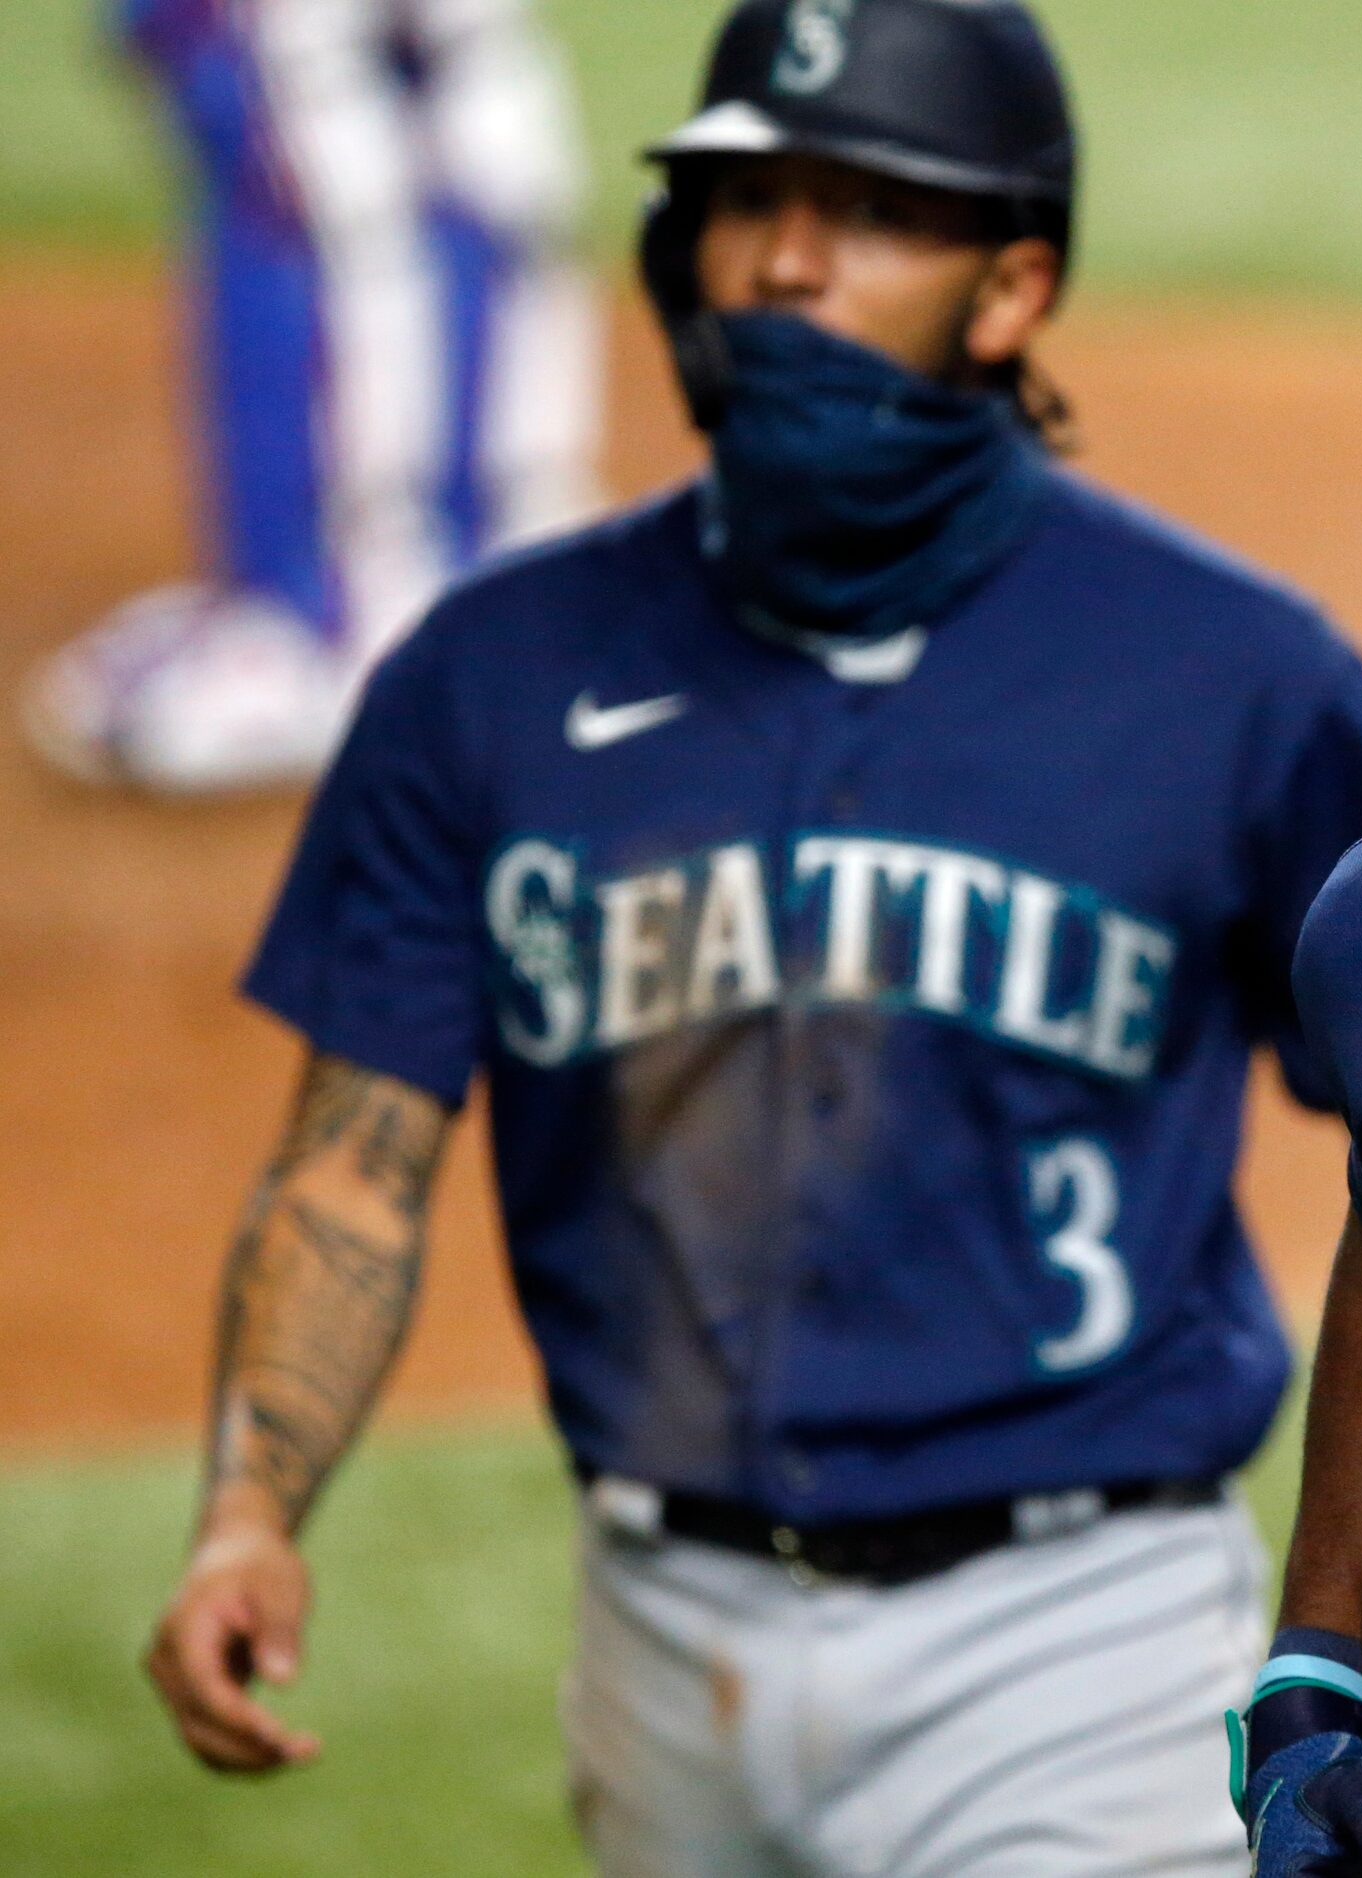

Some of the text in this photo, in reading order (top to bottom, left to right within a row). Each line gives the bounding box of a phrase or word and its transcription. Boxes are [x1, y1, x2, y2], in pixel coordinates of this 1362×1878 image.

[769, 0, 852, 95] S
[485, 830, 1175, 1083] SEATTLE
[1023, 1134, 1138, 1376] 3
